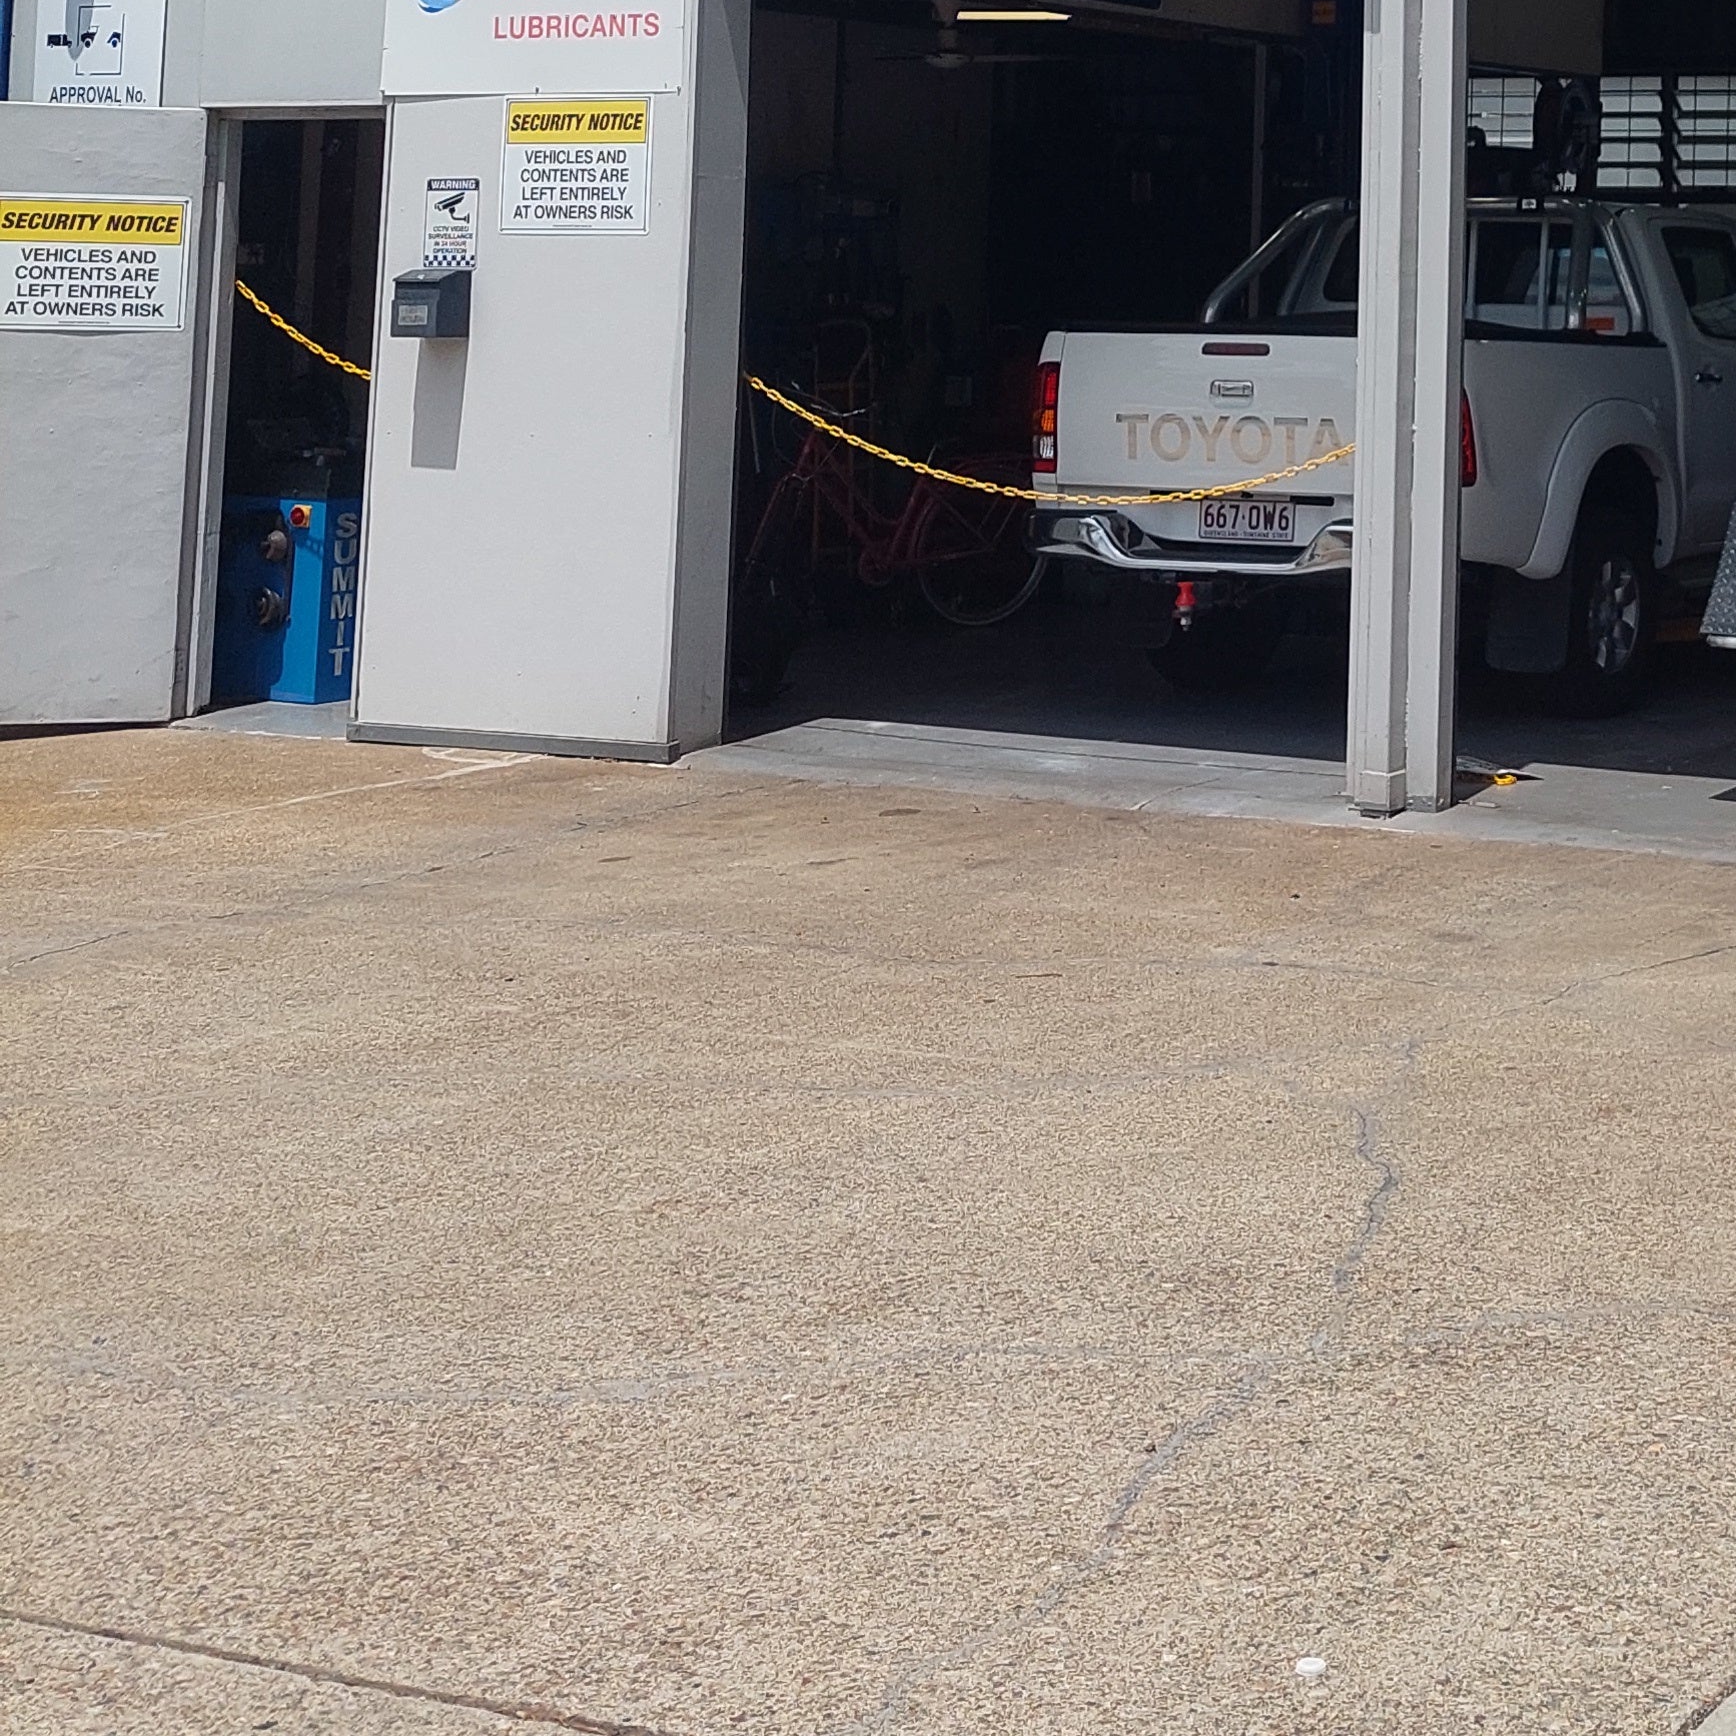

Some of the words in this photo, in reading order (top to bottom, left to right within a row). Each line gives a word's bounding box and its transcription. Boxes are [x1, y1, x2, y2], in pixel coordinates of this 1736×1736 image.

[493, 13, 661, 40] LUBRICANTS
[50, 86, 122, 104] APPROVAL
[125, 85, 147, 104] No.
[511, 113, 586, 131] SECURITY
[588, 112, 644, 131] NOTICE
[524, 149, 594, 164] VEHICLES
[596, 149, 627, 164] AND
[520, 168, 597, 183] CONTENTS
[600, 167, 630, 183] ARE
[431, 179, 476, 190] WARNING
[522, 186, 557, 201] LEFT
[560, 186, 628, 201] ENTIRELY
[513, 204, 532, 219] AT
[534, 204, 598, 219] OWNERS
[600, 204, 634, 219] RISK
[1, 212, 103, 231] SECURITY
[105, 215, 179, 233] NOTICE
[21, 247, 113, 263] VEHICLES
[116, 250, 157, 264] AND
[15, 265, 117, 281] CONTENTS
[121, 267, 160, 282] ARE
[17, 283, 64, 298] LEFT
[68, 284, 157, 300] ENTIRELY
[5, 301, 30, 315] AT
[33, 301, 117, 317] OWNERS
[121, 303, 165, 318] RISK
[1115, 412, 1350, 466] TOYOTA
[328, 512, 359, 678] SUMMIT
